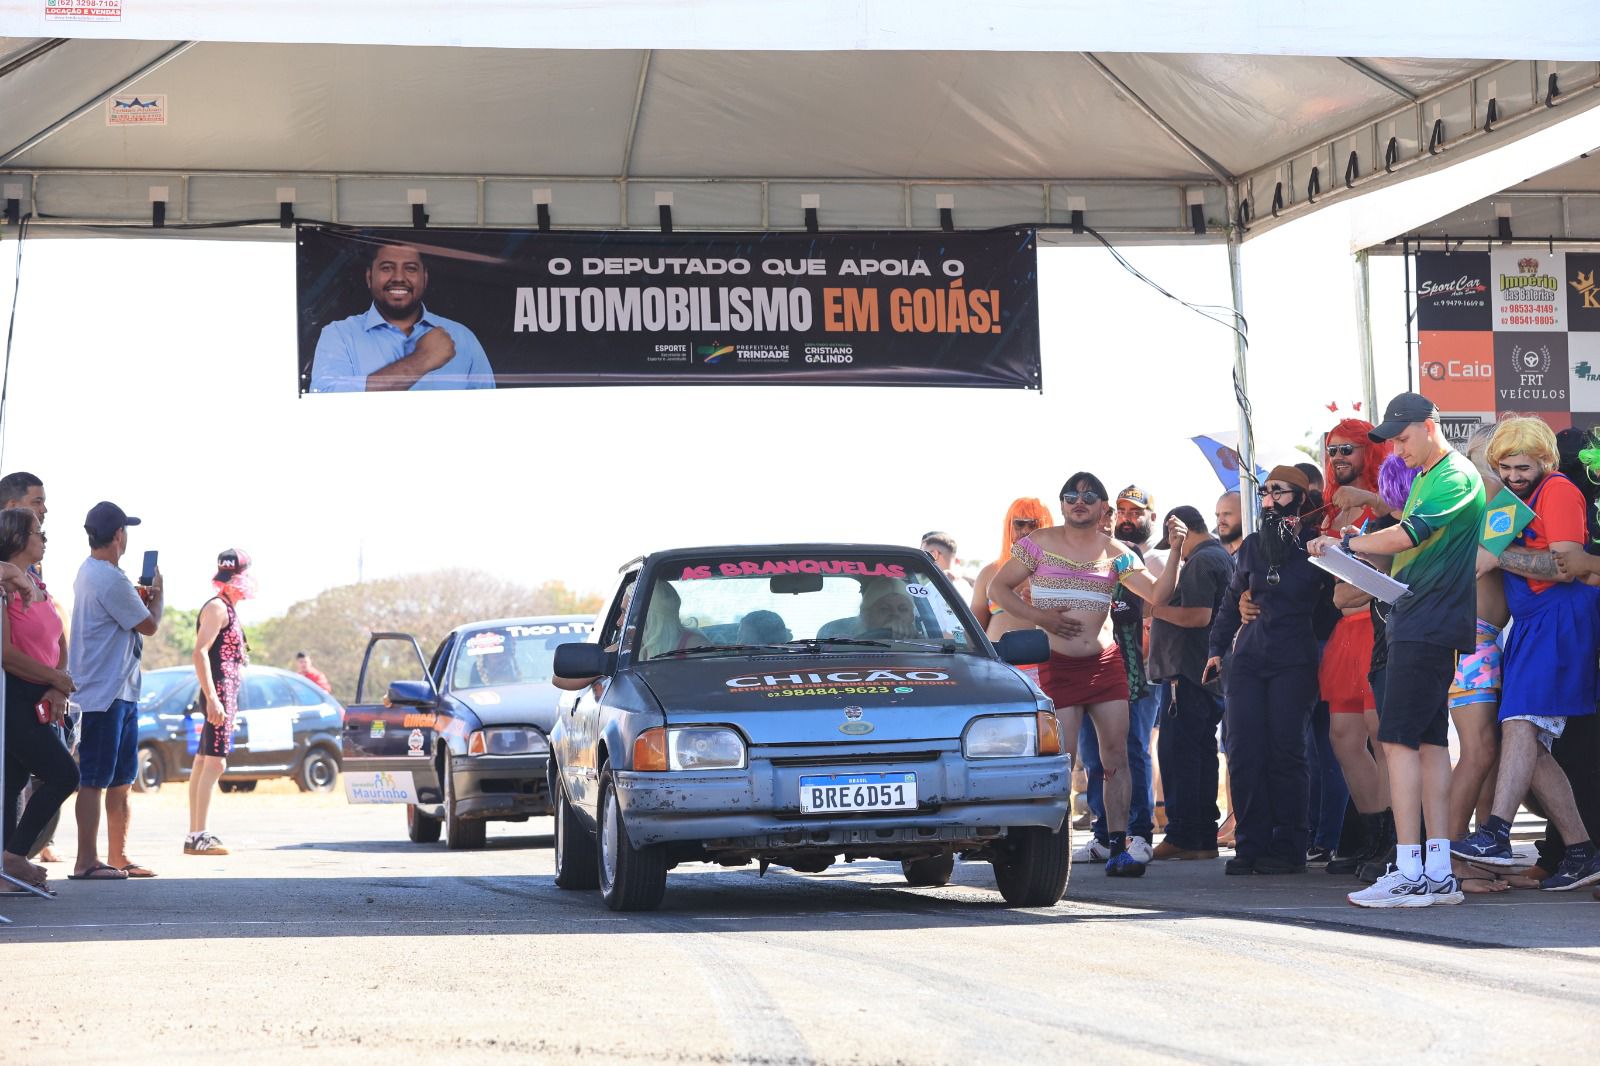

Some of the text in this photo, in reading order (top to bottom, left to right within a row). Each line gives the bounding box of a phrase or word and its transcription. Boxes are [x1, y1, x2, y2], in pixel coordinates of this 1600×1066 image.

[548, 257, 965, 277] O DEPUTADO QUE APOIA O
[1500, 273, 1558, 292] Império
[1503, 288, 1555, 301] das Baterias
[513, 277, 1002, 334] AUTOMOBILISMO EM GOIÁS!
[1508, 304, 1554, 313] 98533-4149
[655, 344, 687, 352] ESPORTE
[736, 350, 790, 359] TRINDADE
[804, 354, 854, 363] GALINDO
[1448, 360, 1492, 377] Caio
[1519, 374, 1545, 386] FRT
[1500, 388, 1566, 399] VEÍCULOS
[681, 559, 907, 581] AS BRANQUELAS
[908, 584, 929, 596] 06
[725, 669, 949, 688] CHICÃO
[352, 788, 408, 799] Maurinho
[811, 784, 906, 809] BRE6D51
